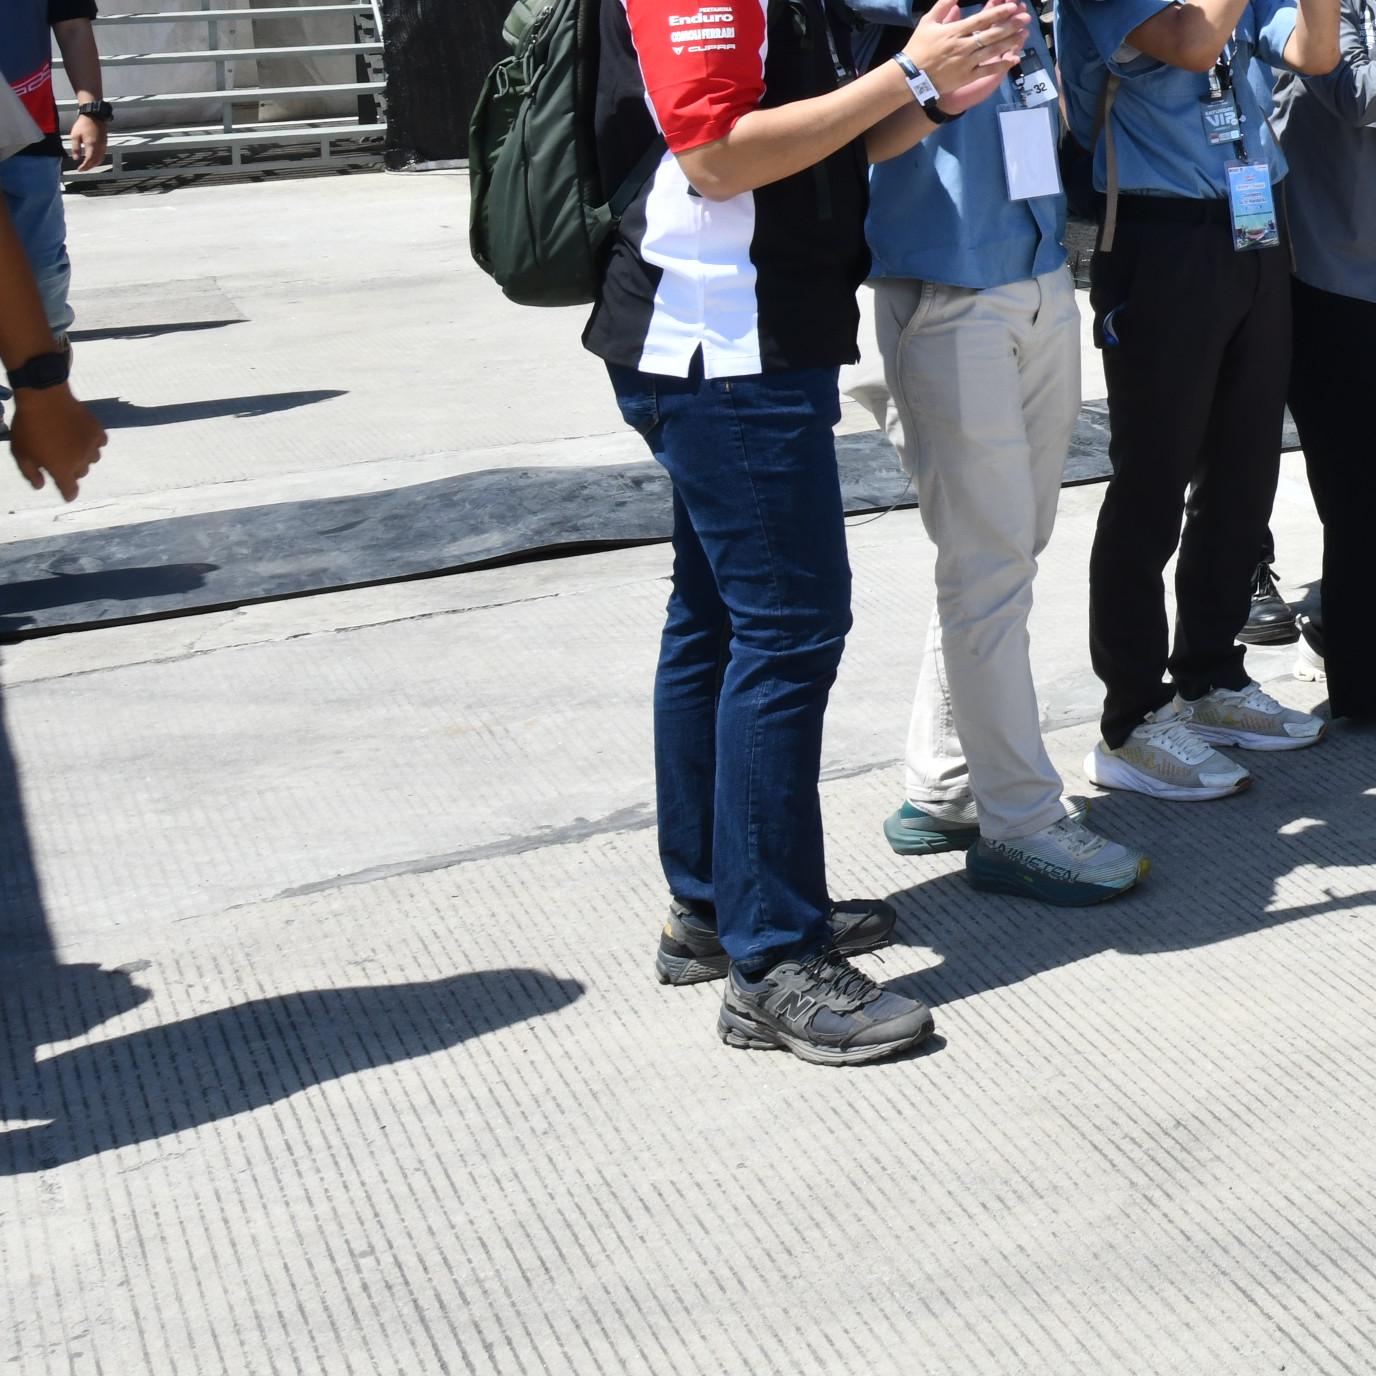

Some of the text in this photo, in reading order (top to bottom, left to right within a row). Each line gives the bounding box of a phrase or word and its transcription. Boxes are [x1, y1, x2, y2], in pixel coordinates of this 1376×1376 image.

[668, 12, 734, 27] Enduro
[1033, 82, 1048, 94] 32
[1205, 113, 1238, 127] VIP
